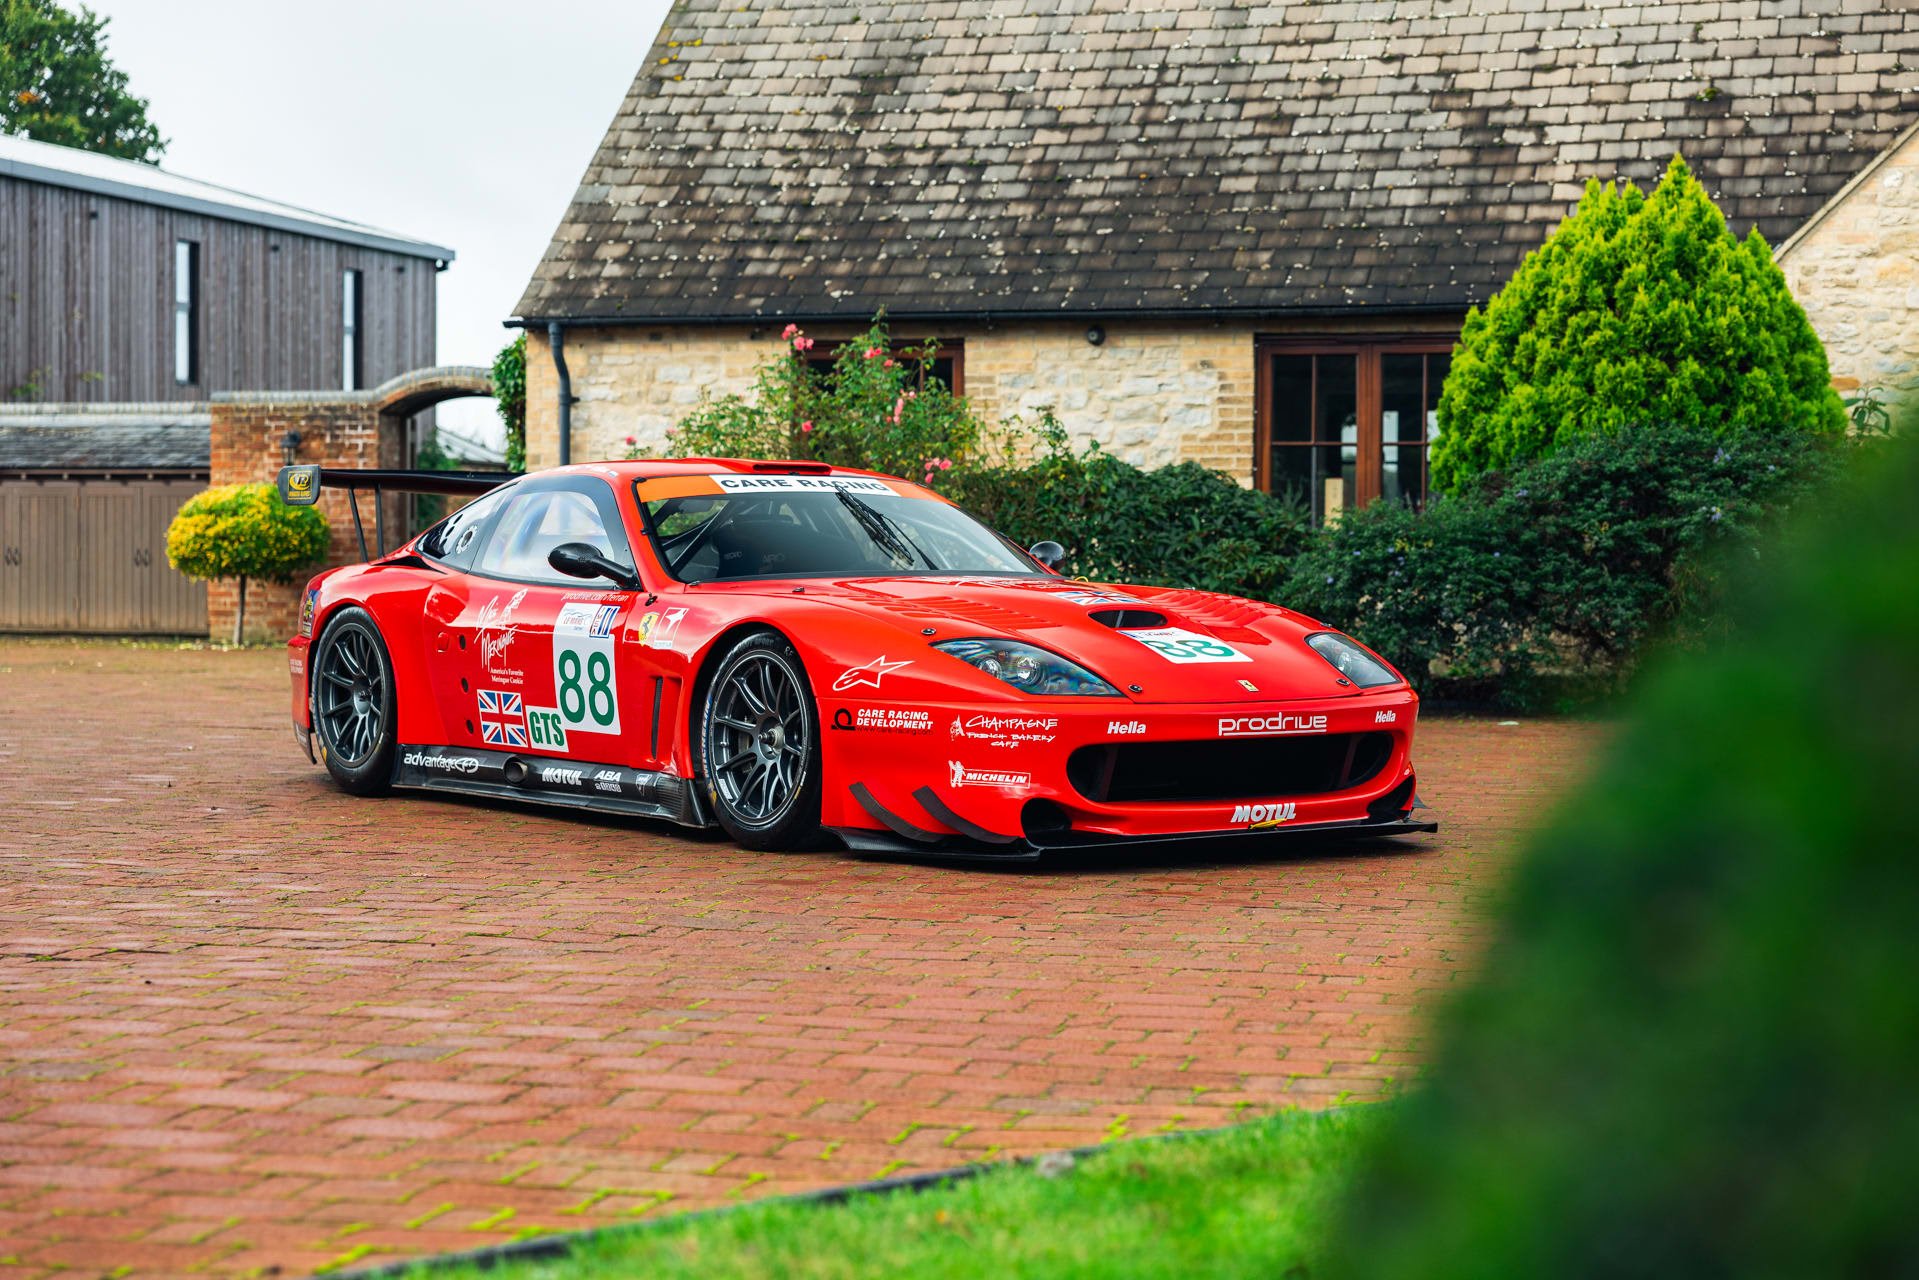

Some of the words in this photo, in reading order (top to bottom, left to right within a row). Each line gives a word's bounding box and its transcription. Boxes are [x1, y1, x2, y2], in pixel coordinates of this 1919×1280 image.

[721, 479, 792, 489] CARE
[797, 479, 890, 491] RACING
[1140, 639, 1235, 658] 88
[559, 649, 615, 727] 88
[858, 708, 886, 719] CARE
[888, 710, 929, 721] RACING
[1375, 711, 1397, 724] Hella
[529, 711, 565, 747] GTS
[856, 718, 934, 730] DEVELOPMENT
[965, 715, 1059, 732] CHAMPAGNE
[1107, 721, 1147, 735] Hella
[1218, 712, 1328, 736] prodrive
[966, 732, 1008, 740] FRENCH
[1011, 734, 1057, 743] BAKERY
[991, 741, 1020, 749] CAFE
[541, 767, 583, 786] MOTUL
[594, 770, 622, 782] ABA
[965, 772, 1028, 784] MICHELIN
[1231, 803, 1297, 823] MOTUL
